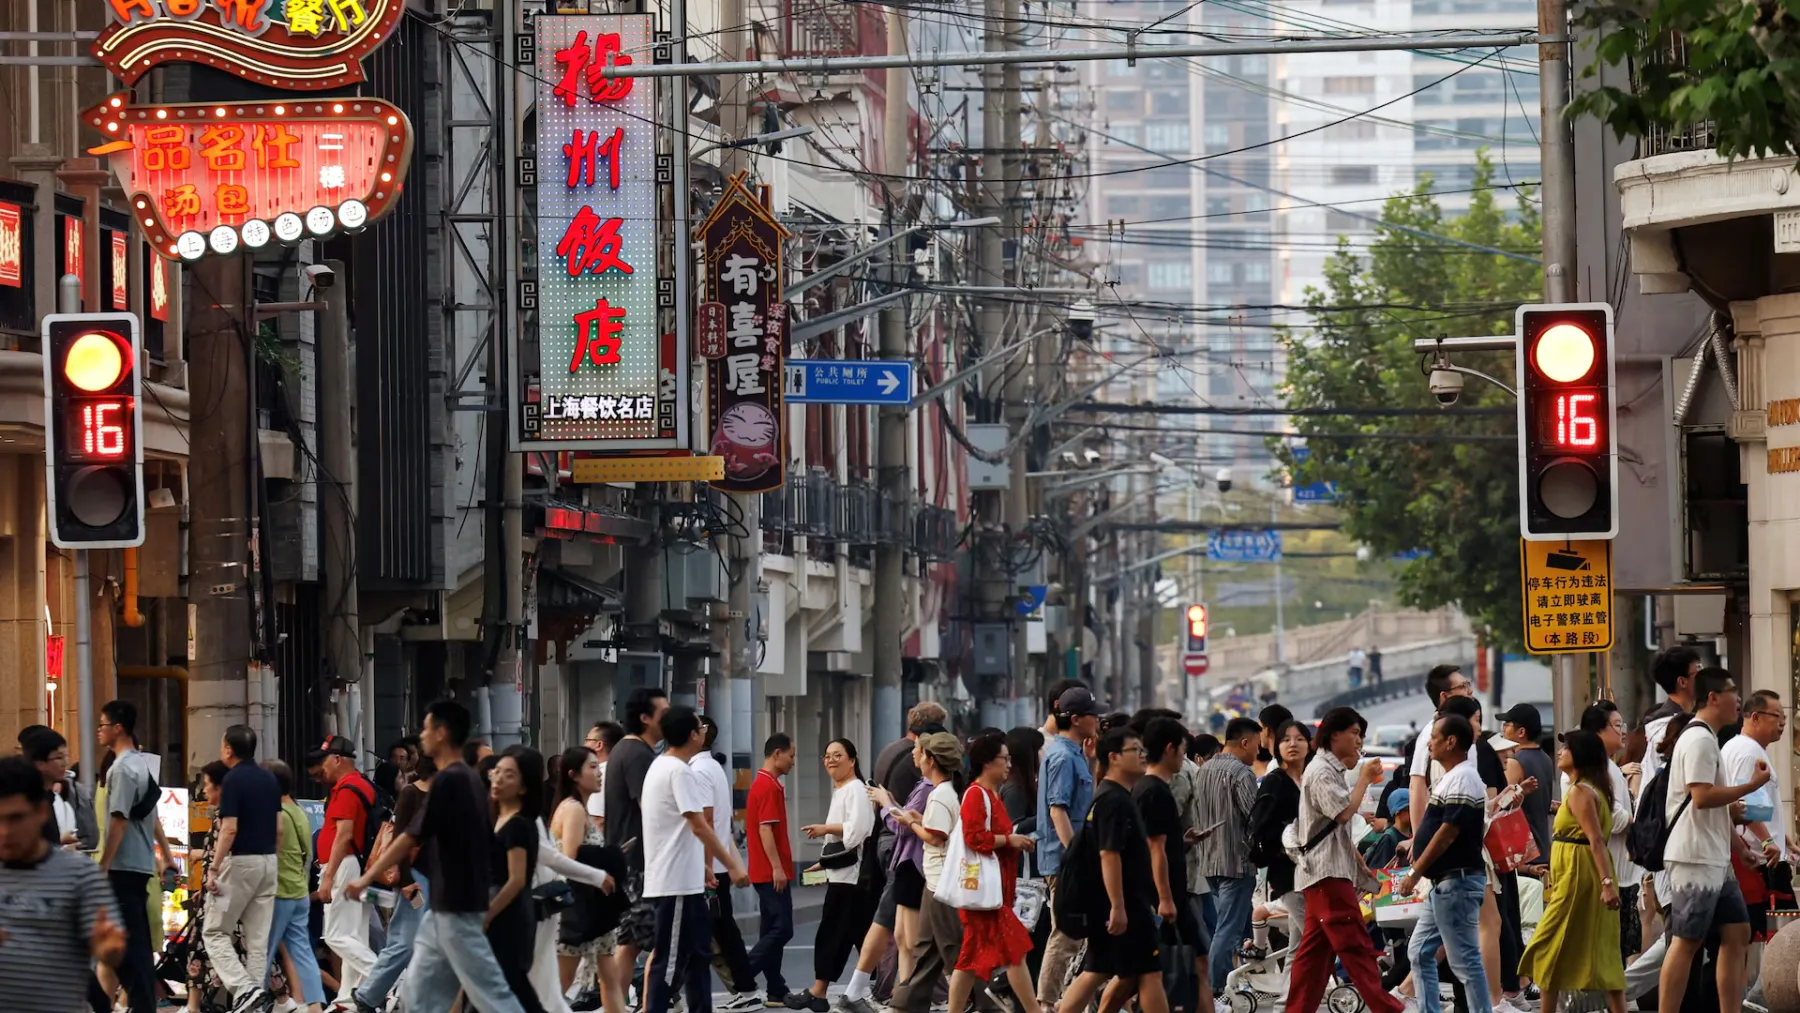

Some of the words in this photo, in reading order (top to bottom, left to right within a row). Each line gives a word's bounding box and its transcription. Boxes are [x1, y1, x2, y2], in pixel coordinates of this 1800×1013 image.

[287, 0, 366, 36] 餐厅
[88, 125, 300, 171] 一品名仕
[165, 183, 250, 217] 汤包
[706, 306, 719, 355] 日本料理
[721, 253, 766, 397] 有喜屋
[760, 303, 787, 371] 深夜食堂
[815, 377, 839, 385] PUBLIC
[843, 378, 866, 386] TOILET
[544, 396, 654, 419] 上海餐饮名店
[1557, 394, 1597, 446] 16
[83, 403, 124, 454] 16
[1528, 574, 1607, 591] 停车行为违法
[1537, 592, 1602, 609] 请立即驶离
[1530, 611, 1607, 628] 电子警察监管
